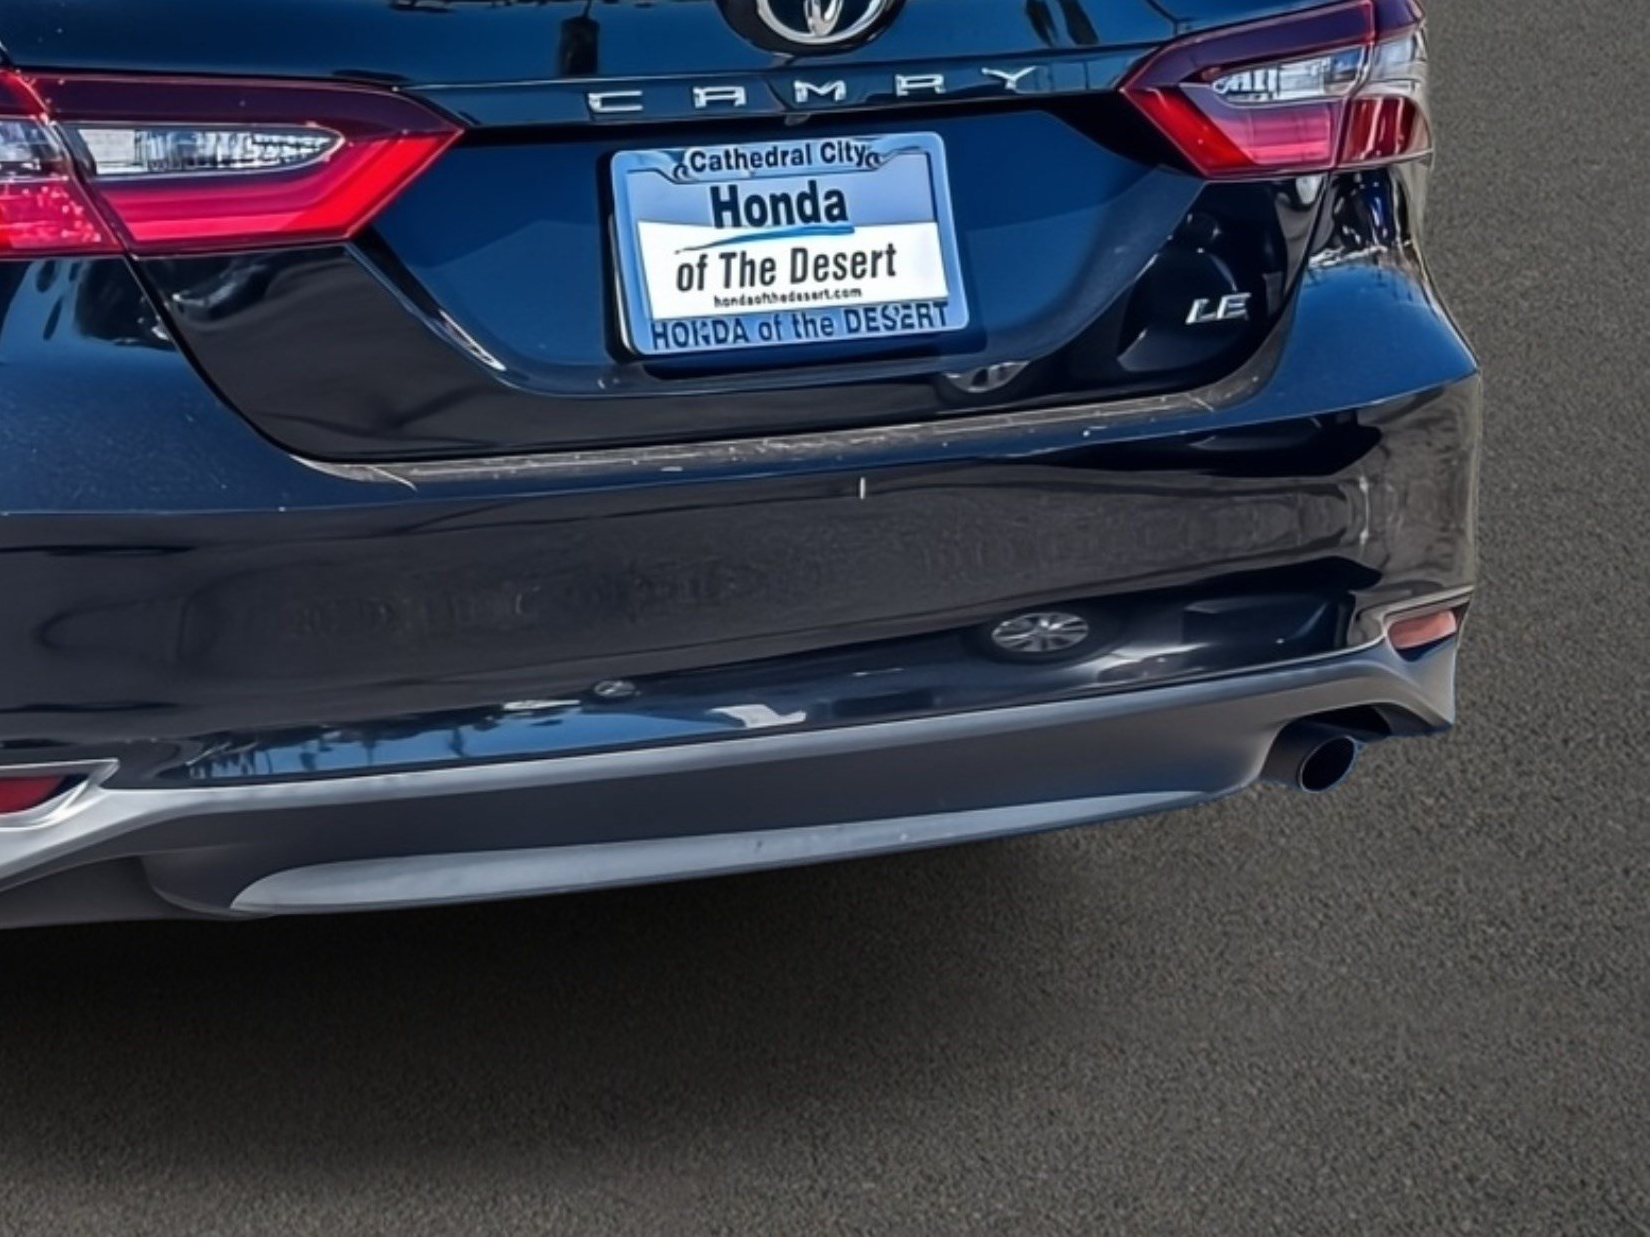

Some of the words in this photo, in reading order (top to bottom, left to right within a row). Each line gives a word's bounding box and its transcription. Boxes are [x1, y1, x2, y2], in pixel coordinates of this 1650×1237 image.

[586, 66, 1036, 113] CAMRY
[689, 143, 812, 173] Cathedral
[820, 140, 867, 168] City
[710, 180, 849, 229] Honda
[676, 253, 708, 291] of
[719, 251, 776, 289] The
[790, 243, 897, 284] Desert
[714, 287, 862, 308] hondaofthedesert.com
[1185, 292, 1252, 324] LE
[652, 318, 749, 350] HONDA
[758, 313, 784, 342] of
[792, 311, 834, 338] the
[844, 301, 949, 333] DESERT
